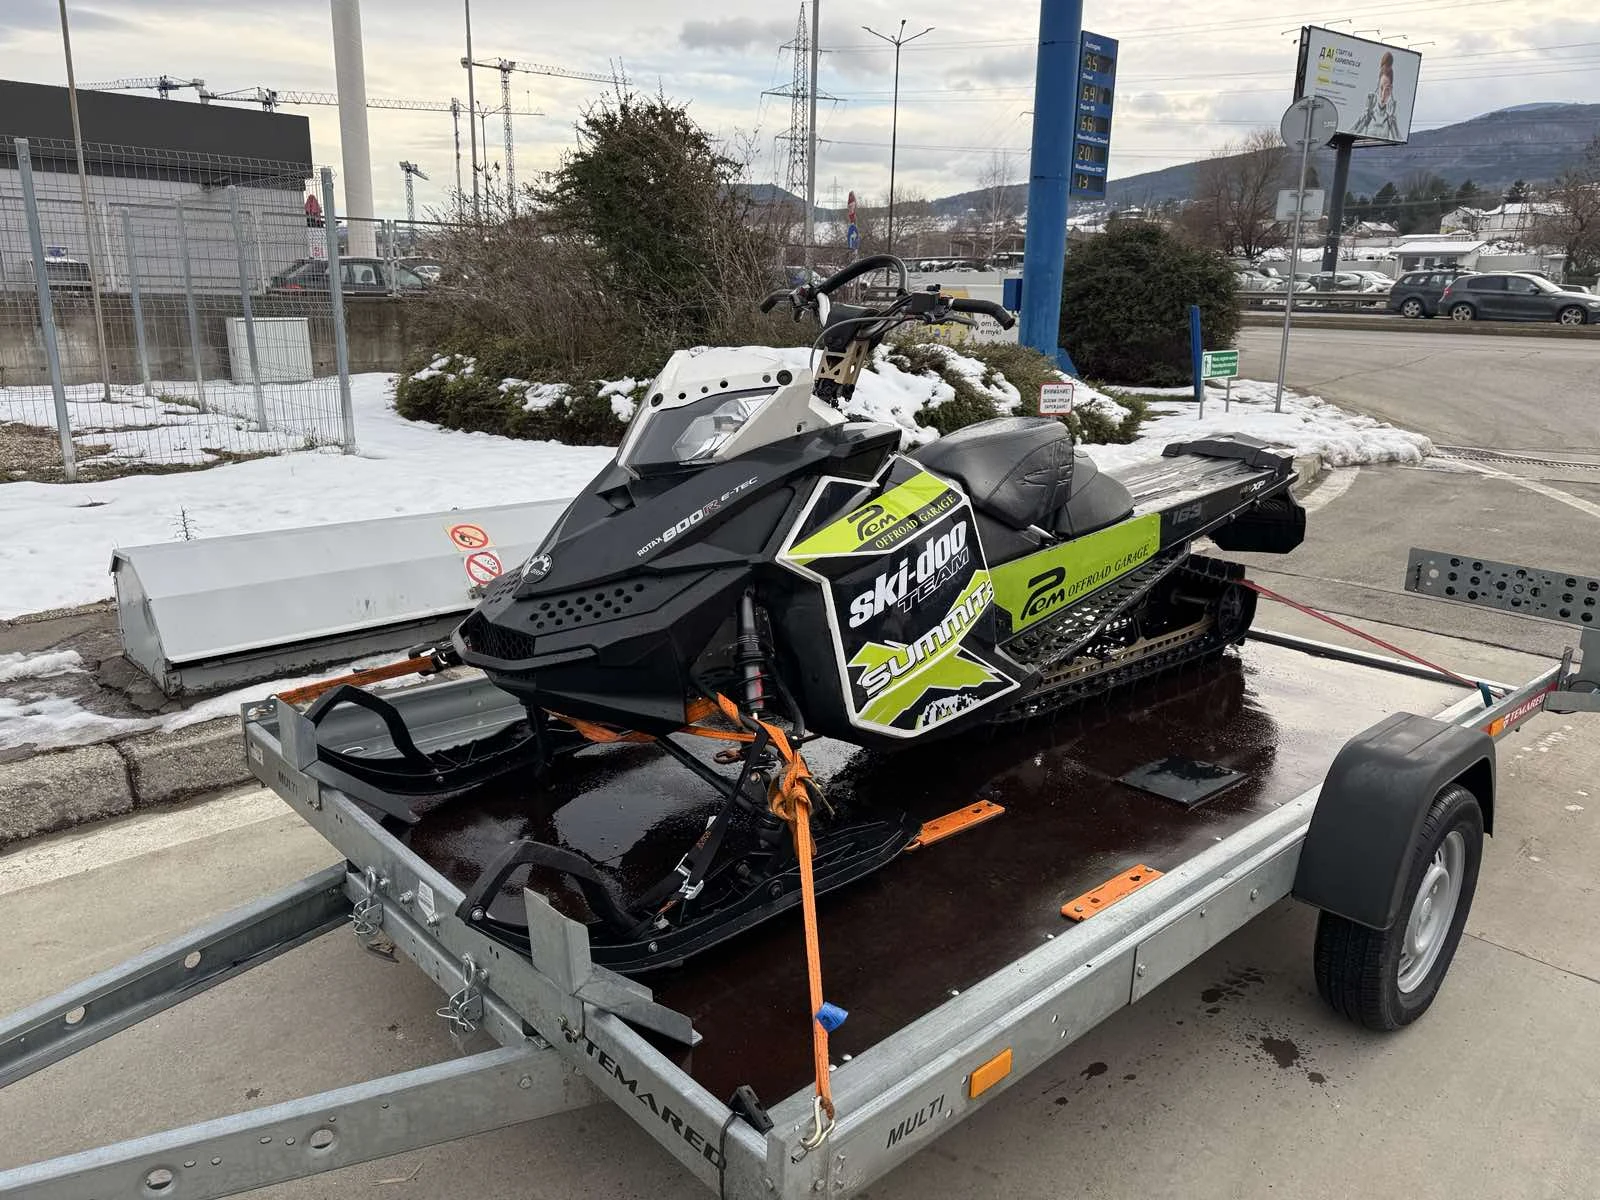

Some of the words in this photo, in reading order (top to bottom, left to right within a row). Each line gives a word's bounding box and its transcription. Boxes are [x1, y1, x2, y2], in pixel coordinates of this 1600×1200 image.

[637, 536, 662, 557] ROTAX
[721, 476, 759, 502] E-TEC
[875, 519, 919, 549] OFFROAD
[919, 494, 956, 522] GARAGE
[849, 520, 967, 628] ski-doo
[898, 547, 969, 613] TEAM
[1068, 565, 1111, 597] OFFROAD
[1114, 544, 1150, 571] GARAGE
[584, 1035, 723, 1170] TEMARED
[886, 1094, 945, 1149] MULTI
